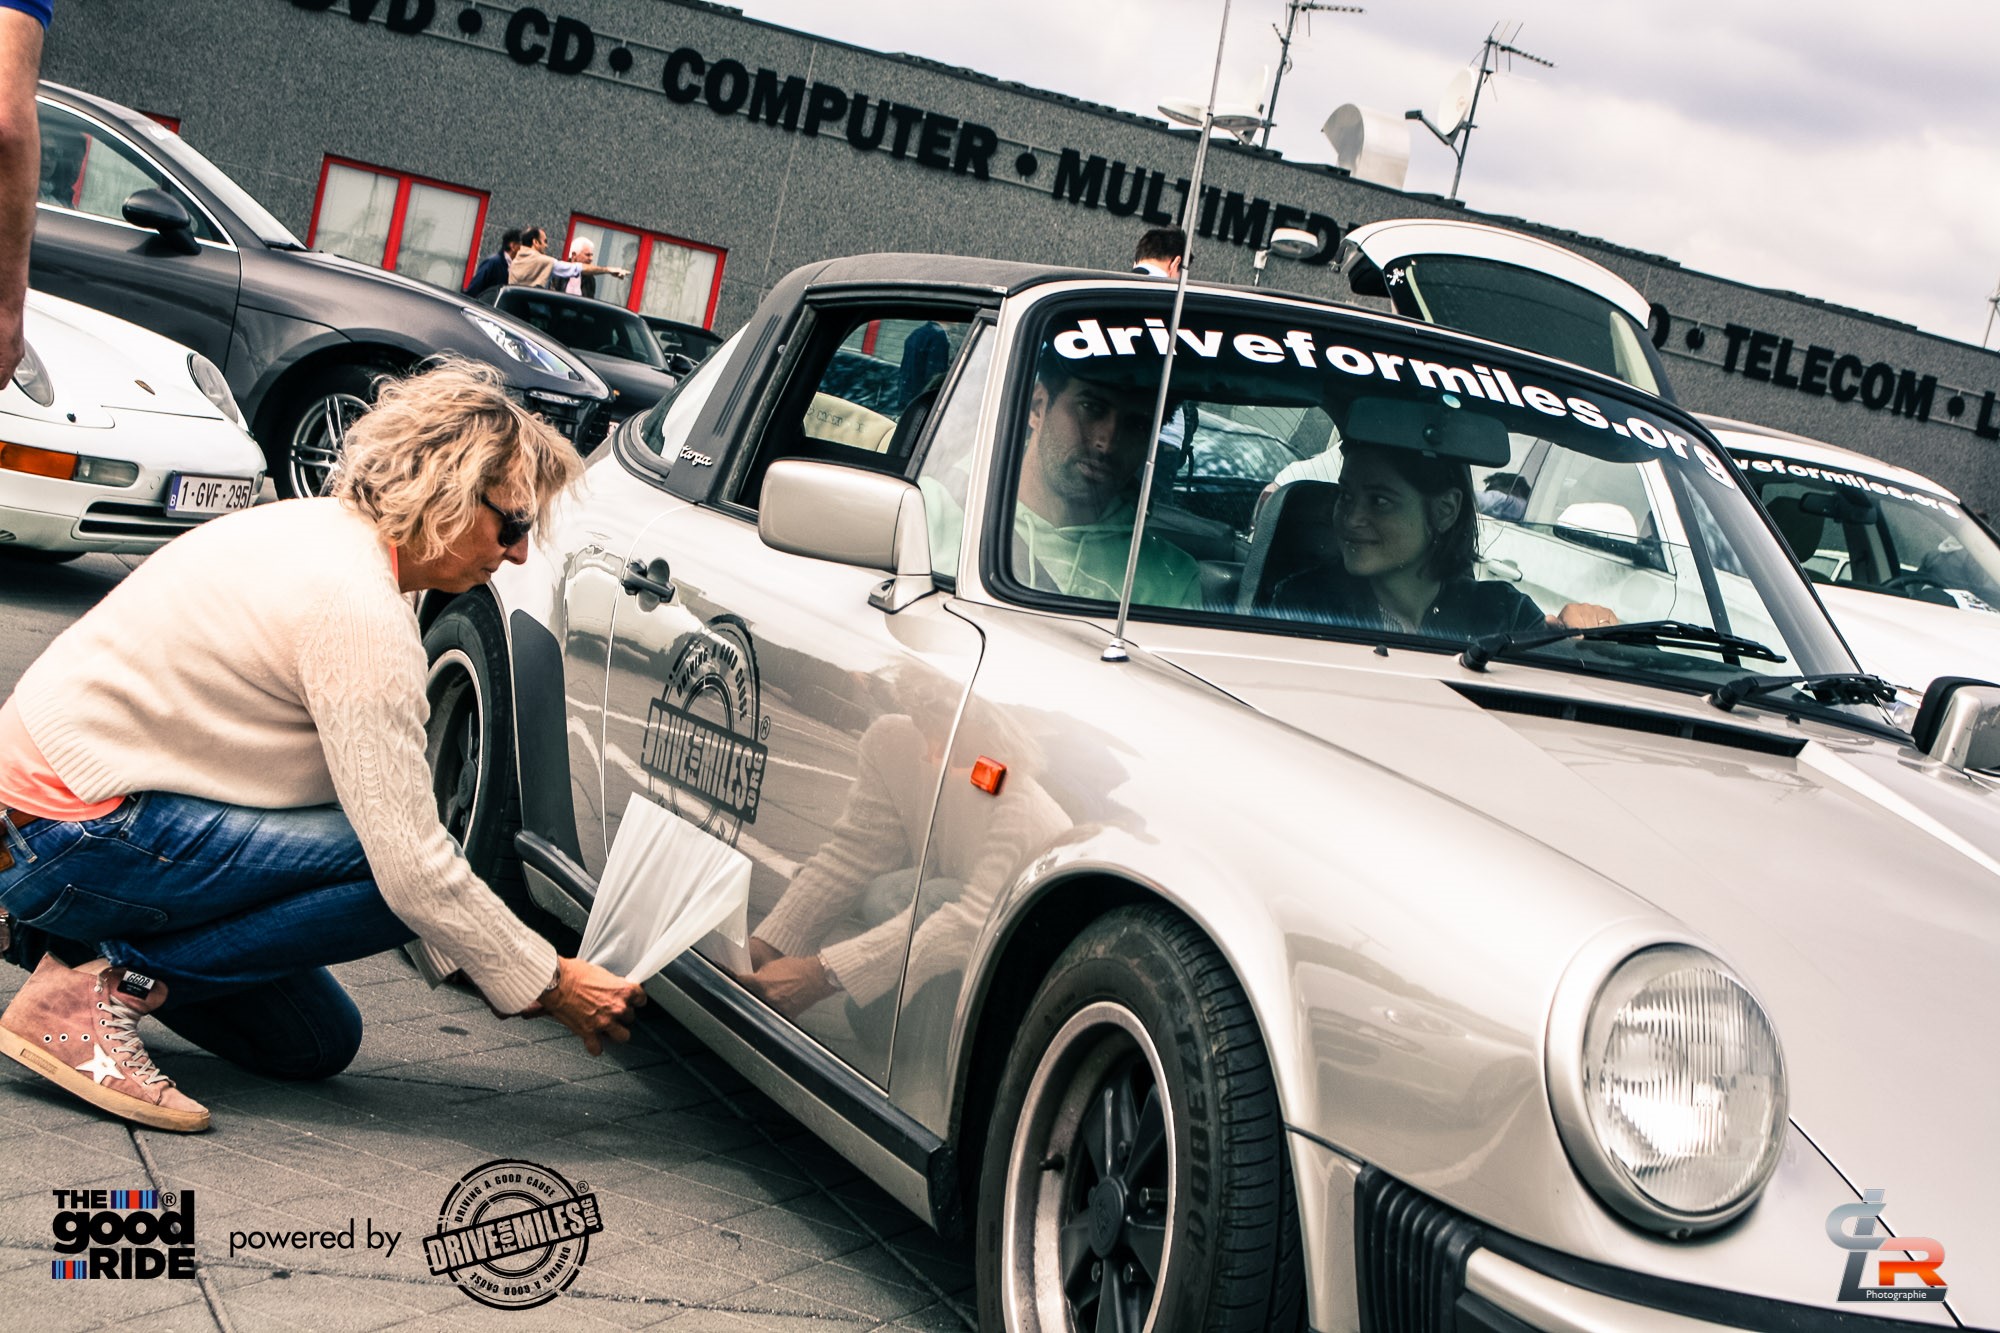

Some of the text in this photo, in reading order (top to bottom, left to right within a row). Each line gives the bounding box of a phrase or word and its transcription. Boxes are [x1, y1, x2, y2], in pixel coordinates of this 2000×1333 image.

[505, 7, 595, 75] CD
[662, 47, 998, 181] COMPUTER
[1722, 322, 1938, 422] TELECOM
[1054, 319, 1736, 490] driveformiles.org
[169, 494, 177, 507] B
[680, 444, 713, 467] targa
